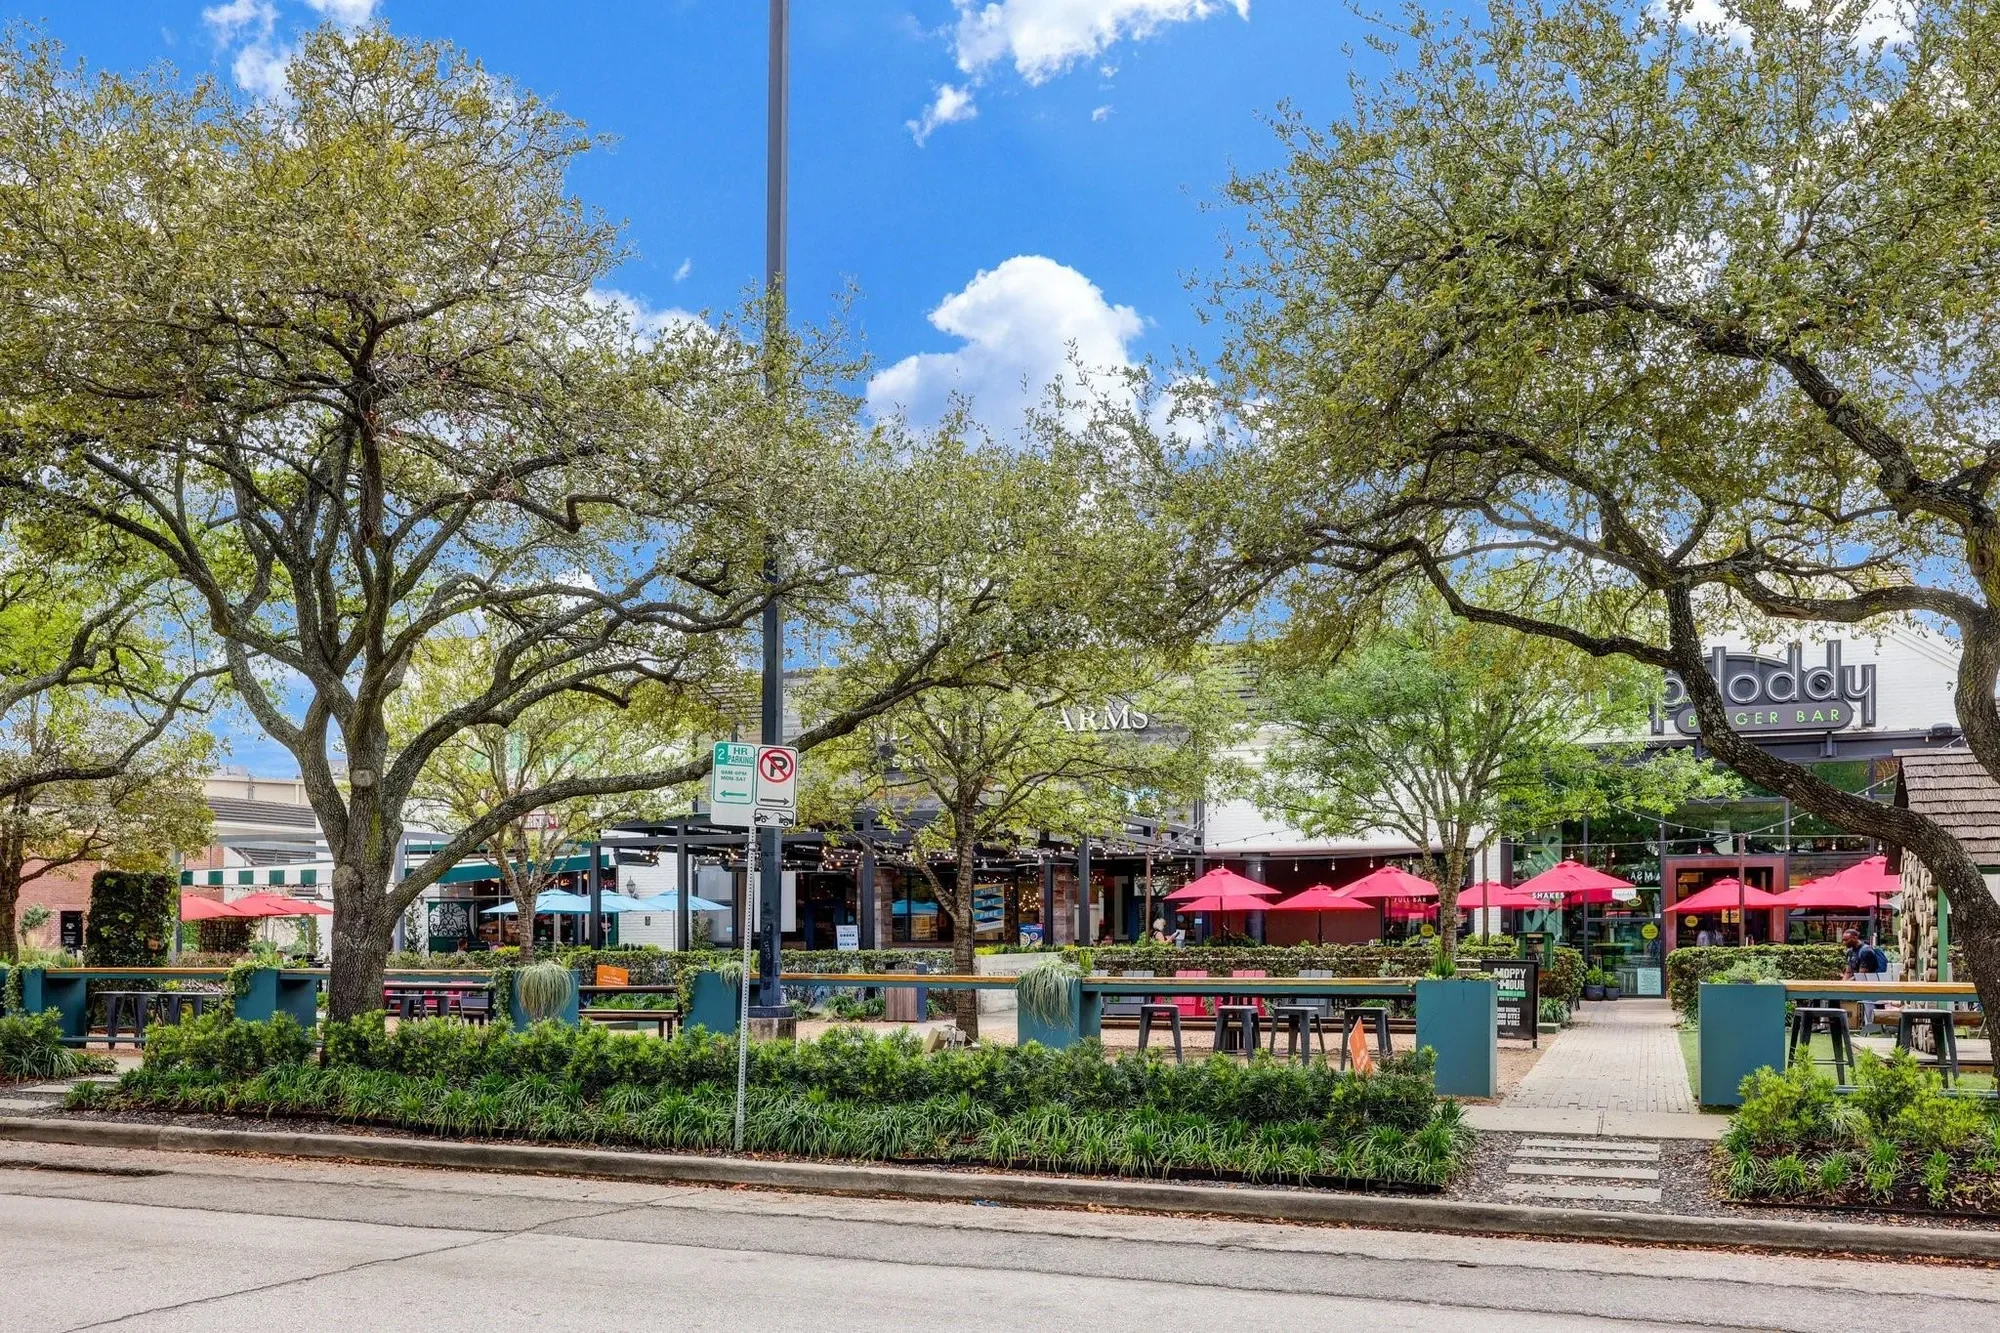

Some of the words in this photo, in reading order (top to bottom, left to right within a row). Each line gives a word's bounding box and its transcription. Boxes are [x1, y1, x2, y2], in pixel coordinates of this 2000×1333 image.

[1687, 711, 1779, 728] BGER
[1796, 708, 1840, 723] BAR
[717, 748, 725, 760] 2
[733, 747, 748, 756] HR
[728, 755, 754, 765] PARKING
[1532, 891, 1565, 899] SHAKES
[982, 899, 995, 907] EAT
[979, 910, 999, 919] FREE
